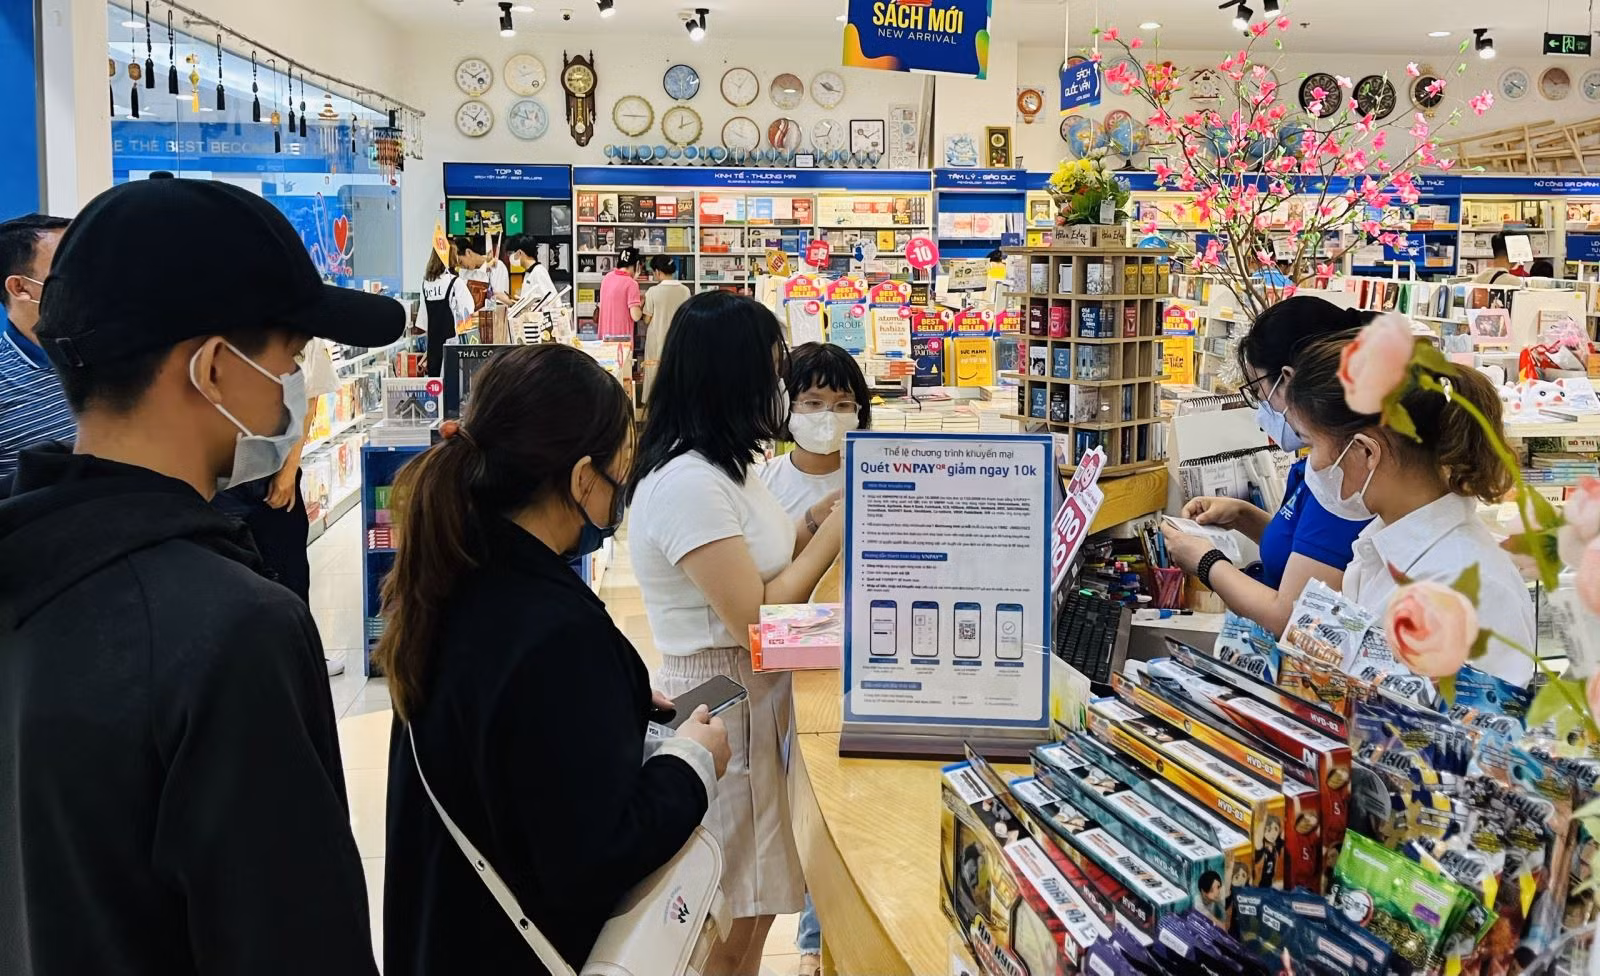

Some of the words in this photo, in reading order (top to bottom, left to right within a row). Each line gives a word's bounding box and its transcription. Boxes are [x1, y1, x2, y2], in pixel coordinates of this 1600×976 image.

[872, 0, 924, 30] SÁCH
[928, 6, 964, 34] MỚI
[878, 28, 904, 38] NEW
[908, 31, 957, 45] ARRIVAL
[132, 140, 161, 152] THE
[166, 140, 205, 152] BEST
[454, 212, 459, 221] 1
[510, 214, 518, 223] 6
[910, 246, 933, 262] -10
[770, 254, 784, 272] NEW
[458, 350, 478, 358] THÁI
[902, 448, 909, 457] lệ
[944, 448, 964, 458] trình
[966, 448, 997, 459] khuyến
[999, 450, 1014, 460] mại
[860, 461, 889, 474] Quét
[947, 462, 976, 477] giảm
[980, 465, 1009, 478] ngay
[1014, 465, 1036, 476] 10k
[1310, 712, 1340, 732] HVD-02
[1217, 799, 1244, 822] HVD-03
